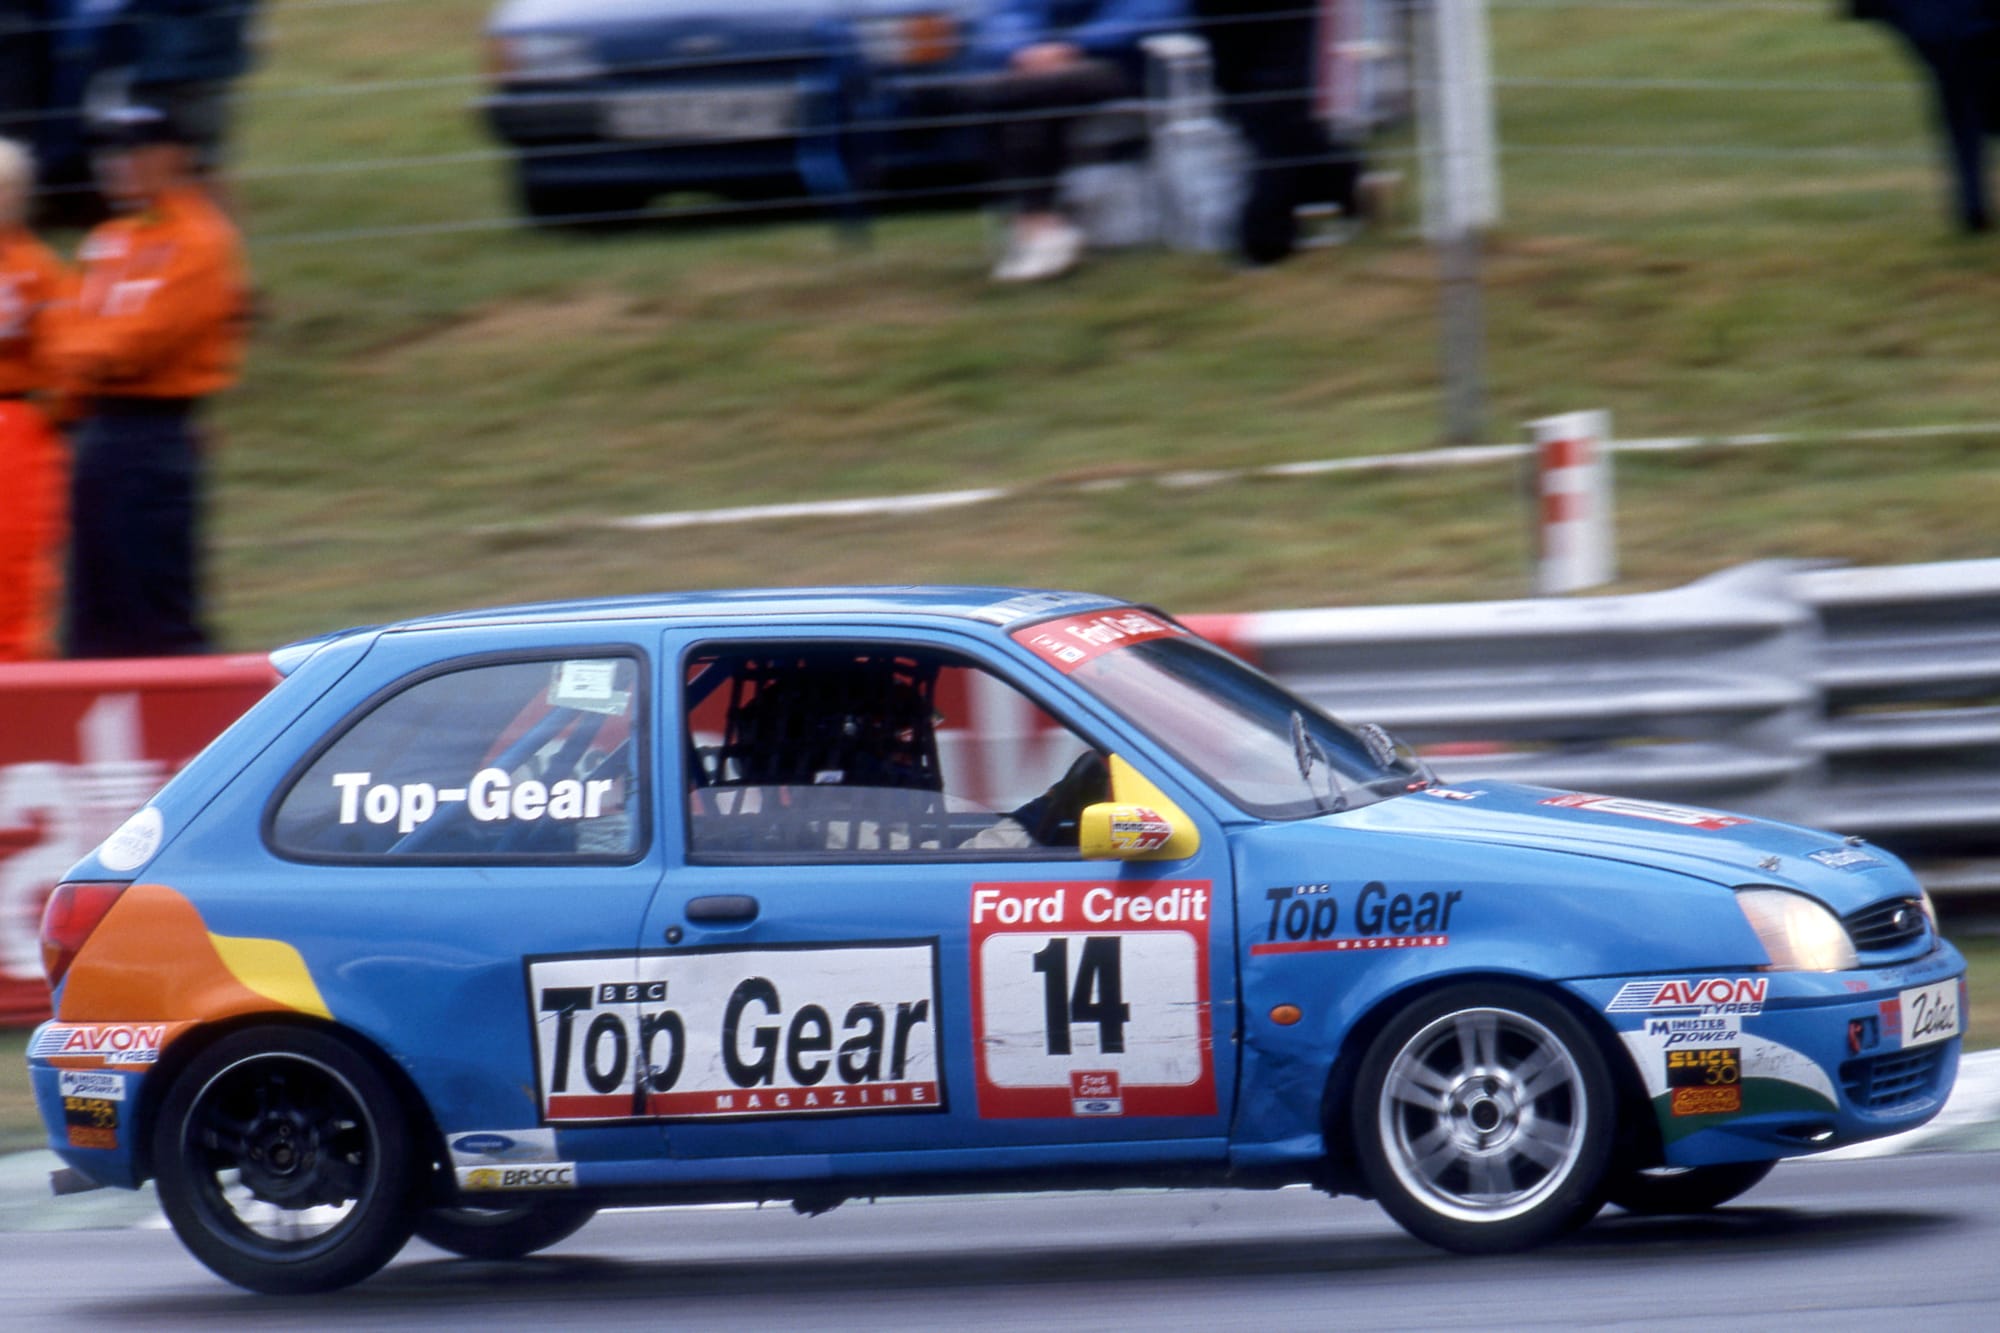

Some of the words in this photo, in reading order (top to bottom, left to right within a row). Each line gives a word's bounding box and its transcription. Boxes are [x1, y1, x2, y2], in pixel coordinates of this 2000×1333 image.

[331, 767, 613, 833] Top-Gear
[1296, 884, 1329, 895] BBC
[972, 889, 1065, 924] Ford
[1081, 887, 1208, 923] Credit
[1266, 887, 1338, 942] Top
[1355, 880, 1462, 936] Gear
[1337, 936, 1446, 949] MAGAZINE
[602, 982, 665, 1002] BBC
[1032, 936, 1131, 1056] 14
[1653, 978, 1767, 1006] AVON
[1702, 1002, 1762, 1014] TYRES
[62, 1028, 162, 1051] AVON
[541, 986, 686, 1116] Top
[721, 975, 929, 1089] Gear
[105, 1050, 160, 1063] TYRES
[1704, 1064, 1739, 1085] 50
[716, 1086, 925, 1111] MAGAZINE
[502, 1168, 572, 1186] BRSCC
